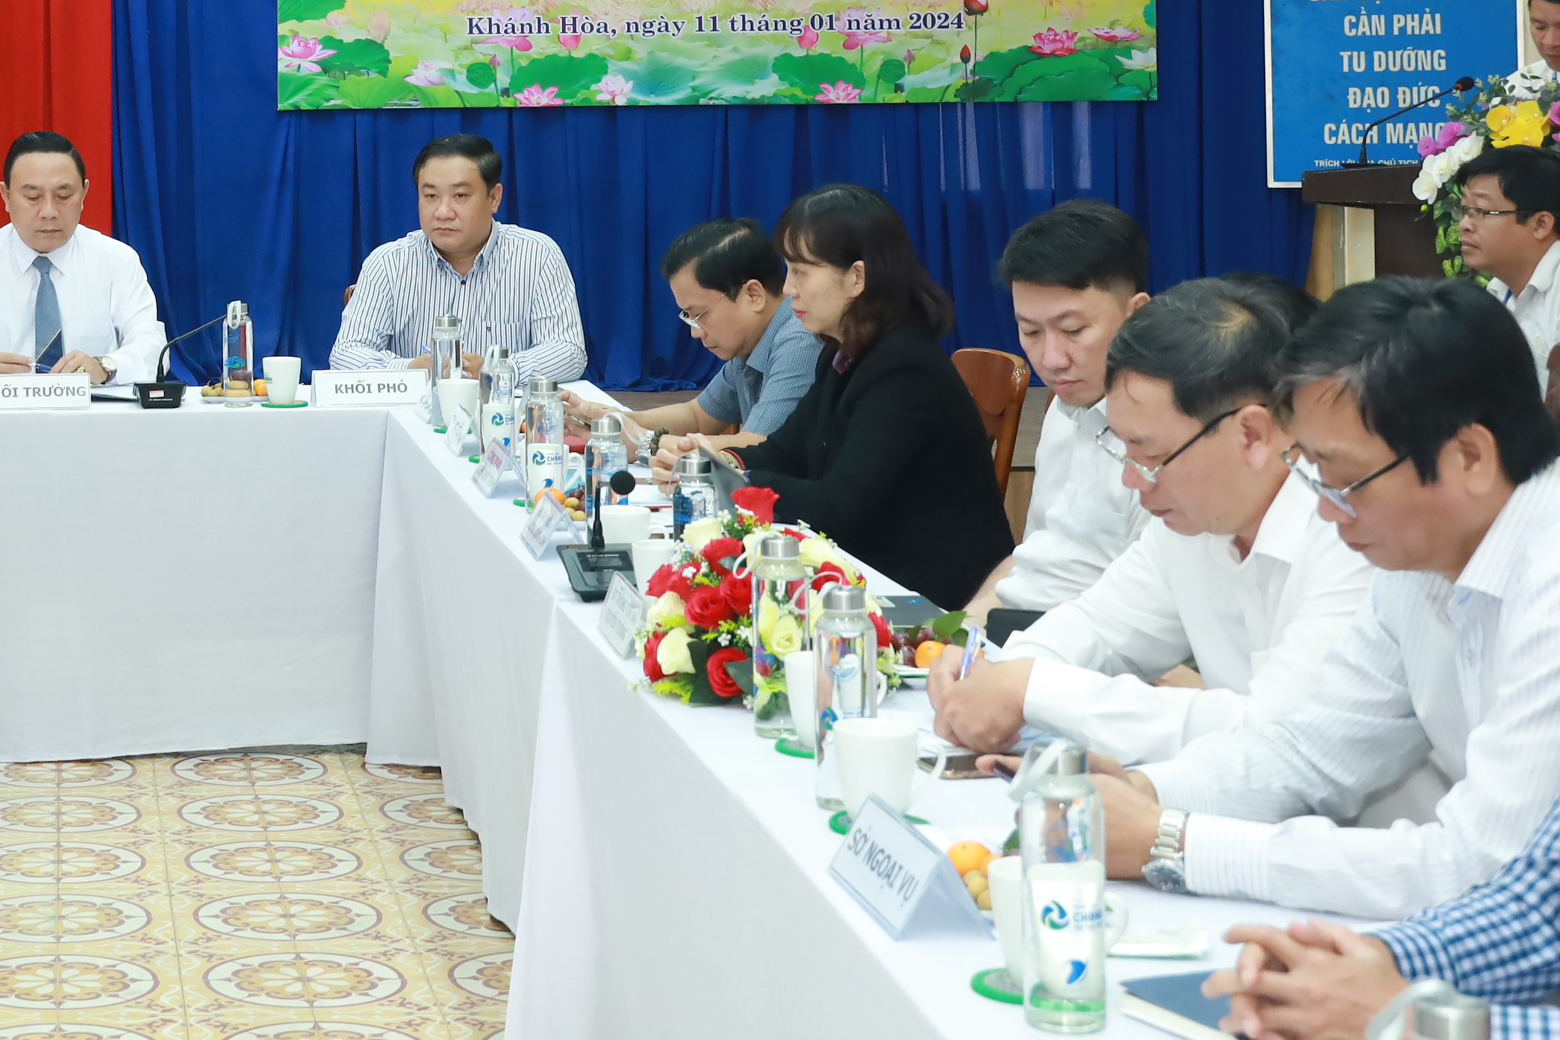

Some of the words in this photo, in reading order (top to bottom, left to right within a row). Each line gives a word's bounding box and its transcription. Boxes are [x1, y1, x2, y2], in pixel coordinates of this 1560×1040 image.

[467, 17, 551, 35] Khánh
[560, 16, 617, 37] Hòa,
[625, 15, 686, 37] ngày
[695, 16, 720, 32] 11
[730, 14, 803, 35] tháng
[810, 13, 836, 30] 01
[846, 13, 901, 31] năm
[909, 12, 963, 30] 2024
[1344, 7, 1385, 37] CẦN
[1393, 8, 1441, 36] PHẢI
[1340, 51, 1366, 72] TU
[1374, 48, 1446, 72] DƯỠNG
[1348, 86, 1390, 112] ĐẠO
[1397, 82, 1440, 108] ĐỨC
[1324, 119, 1378, 145] CÁCH
[1314, 158, 1339, 167] TRÍCH
[23, 383, 86, 397] TRƯỞNG
[335, 379, 372, 394] KHỐI
[377, 379, 408, 393] PHÓ
[847, 825, 871, 857] SỞ
[865, 844, 901, 889] NGOẠI
[898, 877, 920, 907] VỤ
